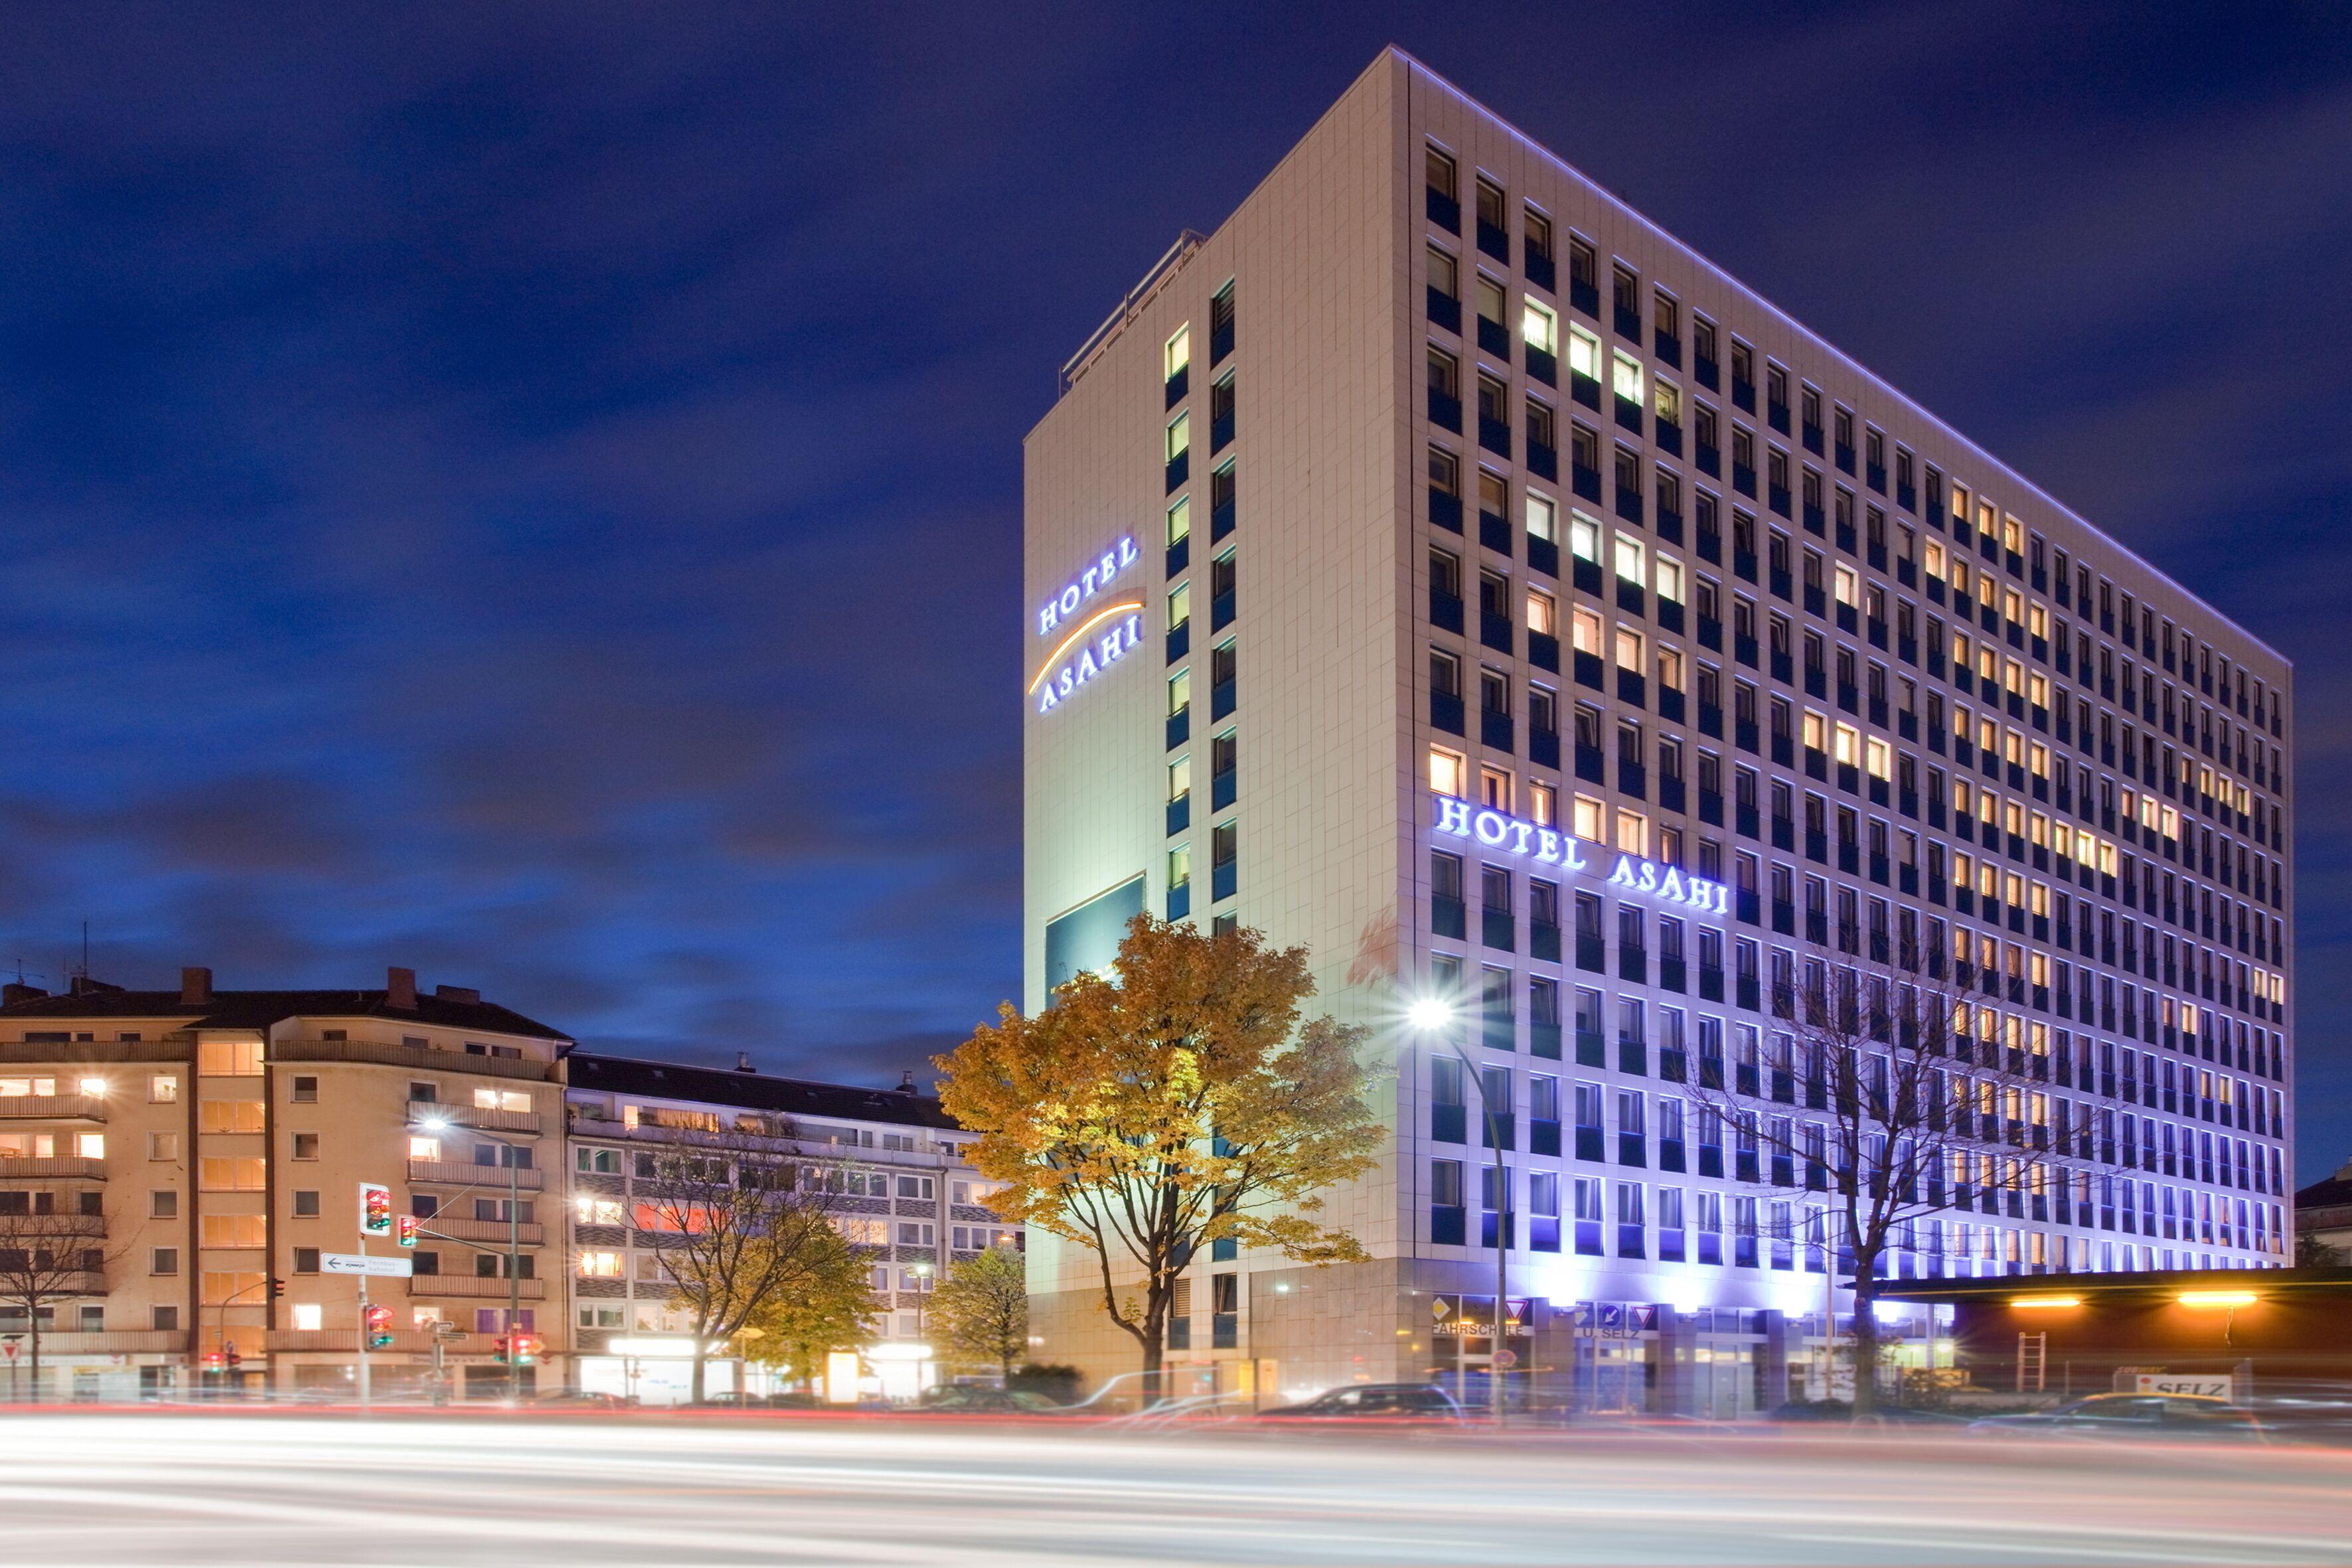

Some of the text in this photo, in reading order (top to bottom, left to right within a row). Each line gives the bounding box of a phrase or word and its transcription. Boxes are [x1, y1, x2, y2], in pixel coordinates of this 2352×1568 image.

[1040, 536, 1139, 636] HOTEL
[1040, 615, 1140, 713] ASAHI
[1437, 797, 1729, 914] HOTEL ASAHI
[1432, 1322, 1523, 1336] FAHRSCHLE
[1601, 1328, 1640, 1339] SELZ
